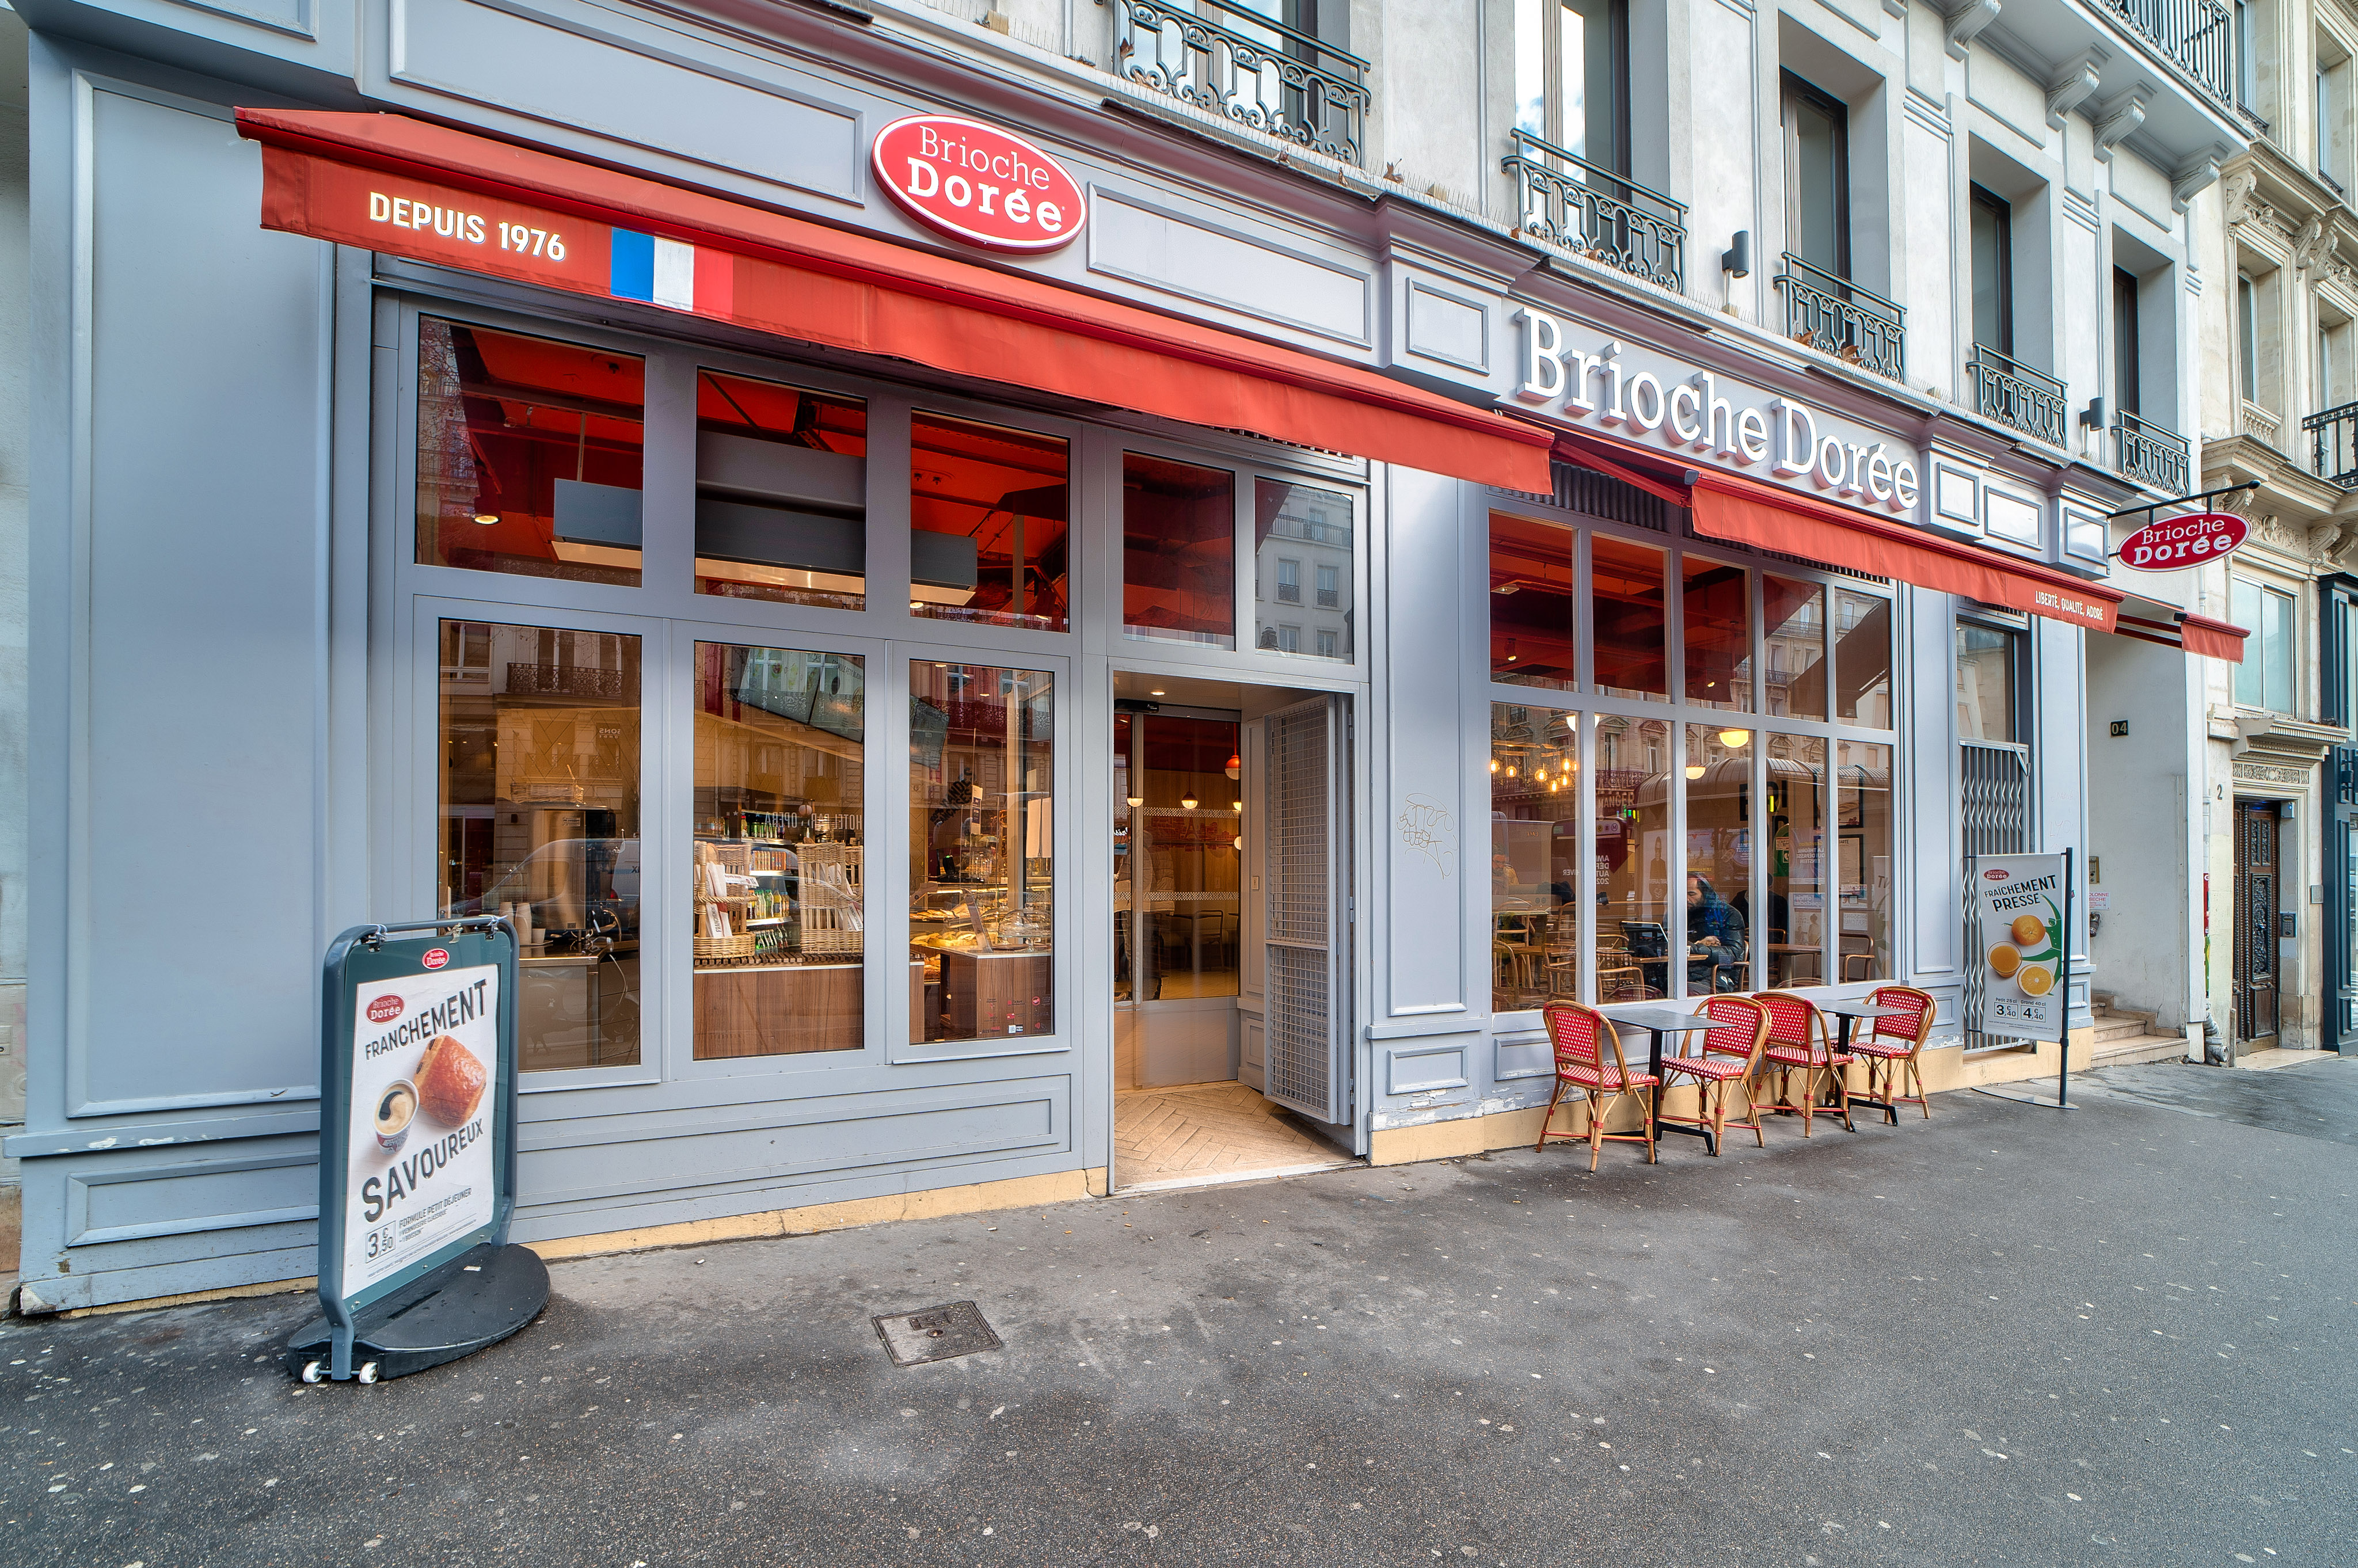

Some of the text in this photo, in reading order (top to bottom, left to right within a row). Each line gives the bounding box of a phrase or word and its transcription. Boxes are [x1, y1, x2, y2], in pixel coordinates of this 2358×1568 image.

[919, 125, 1050, 191] Brioche
[907, 156, 1063, 233] Dorée
[369, 191, 566, 262] DEPUIS 1976
[1515, 306, 1919, 512] Brioche Dorée
[2142, 519, 2226, 545] Brioche
[2133, 534, 2233, 565] Dorée
[2035, 591, 2104, 621] LIBERTÉ, QUALITÉ, ADORÉ
[2111, 722, 2128, 734] 04
[2217, 784, 2223, 800] 2
[1984, 874, 2056, 898] FRAÎCHEMENT
[370, 1006, 401, 1020] Dorée
[372, 997, 400, 1009] Brioche
[364, 979, 488, 1060] FRANCHEMENT
[361, 1118, 484, 1223] SAVOUREUX
[399, 1208, 427, 1230] FORMULE
[427, 1201, 443, 1216] PETIT
